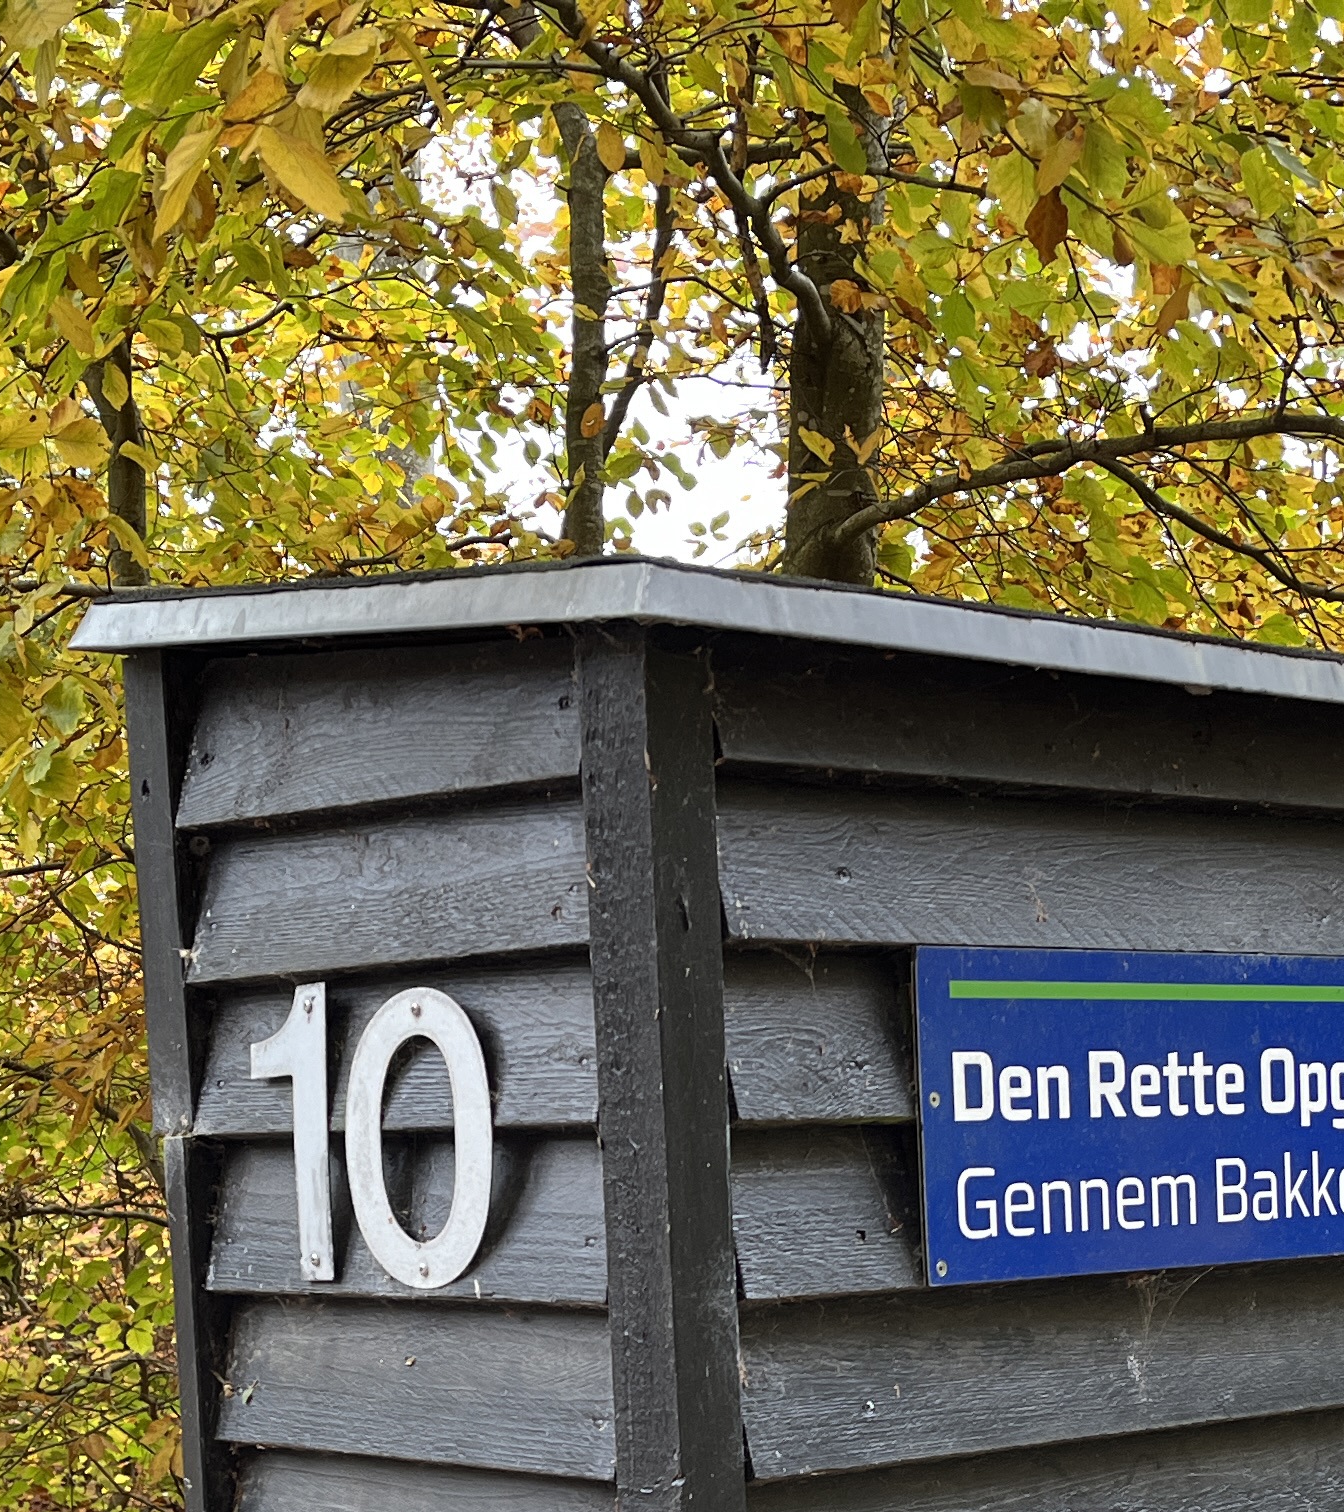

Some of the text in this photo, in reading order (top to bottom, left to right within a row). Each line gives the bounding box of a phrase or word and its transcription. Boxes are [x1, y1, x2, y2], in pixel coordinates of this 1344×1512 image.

[951, 1050, 1072, 1123] Den
[1087, 1049, 1246, 1120] Rette
[250, 981, 493, 1290] 10
[956, 1165, 1198, 1241] Gennem
